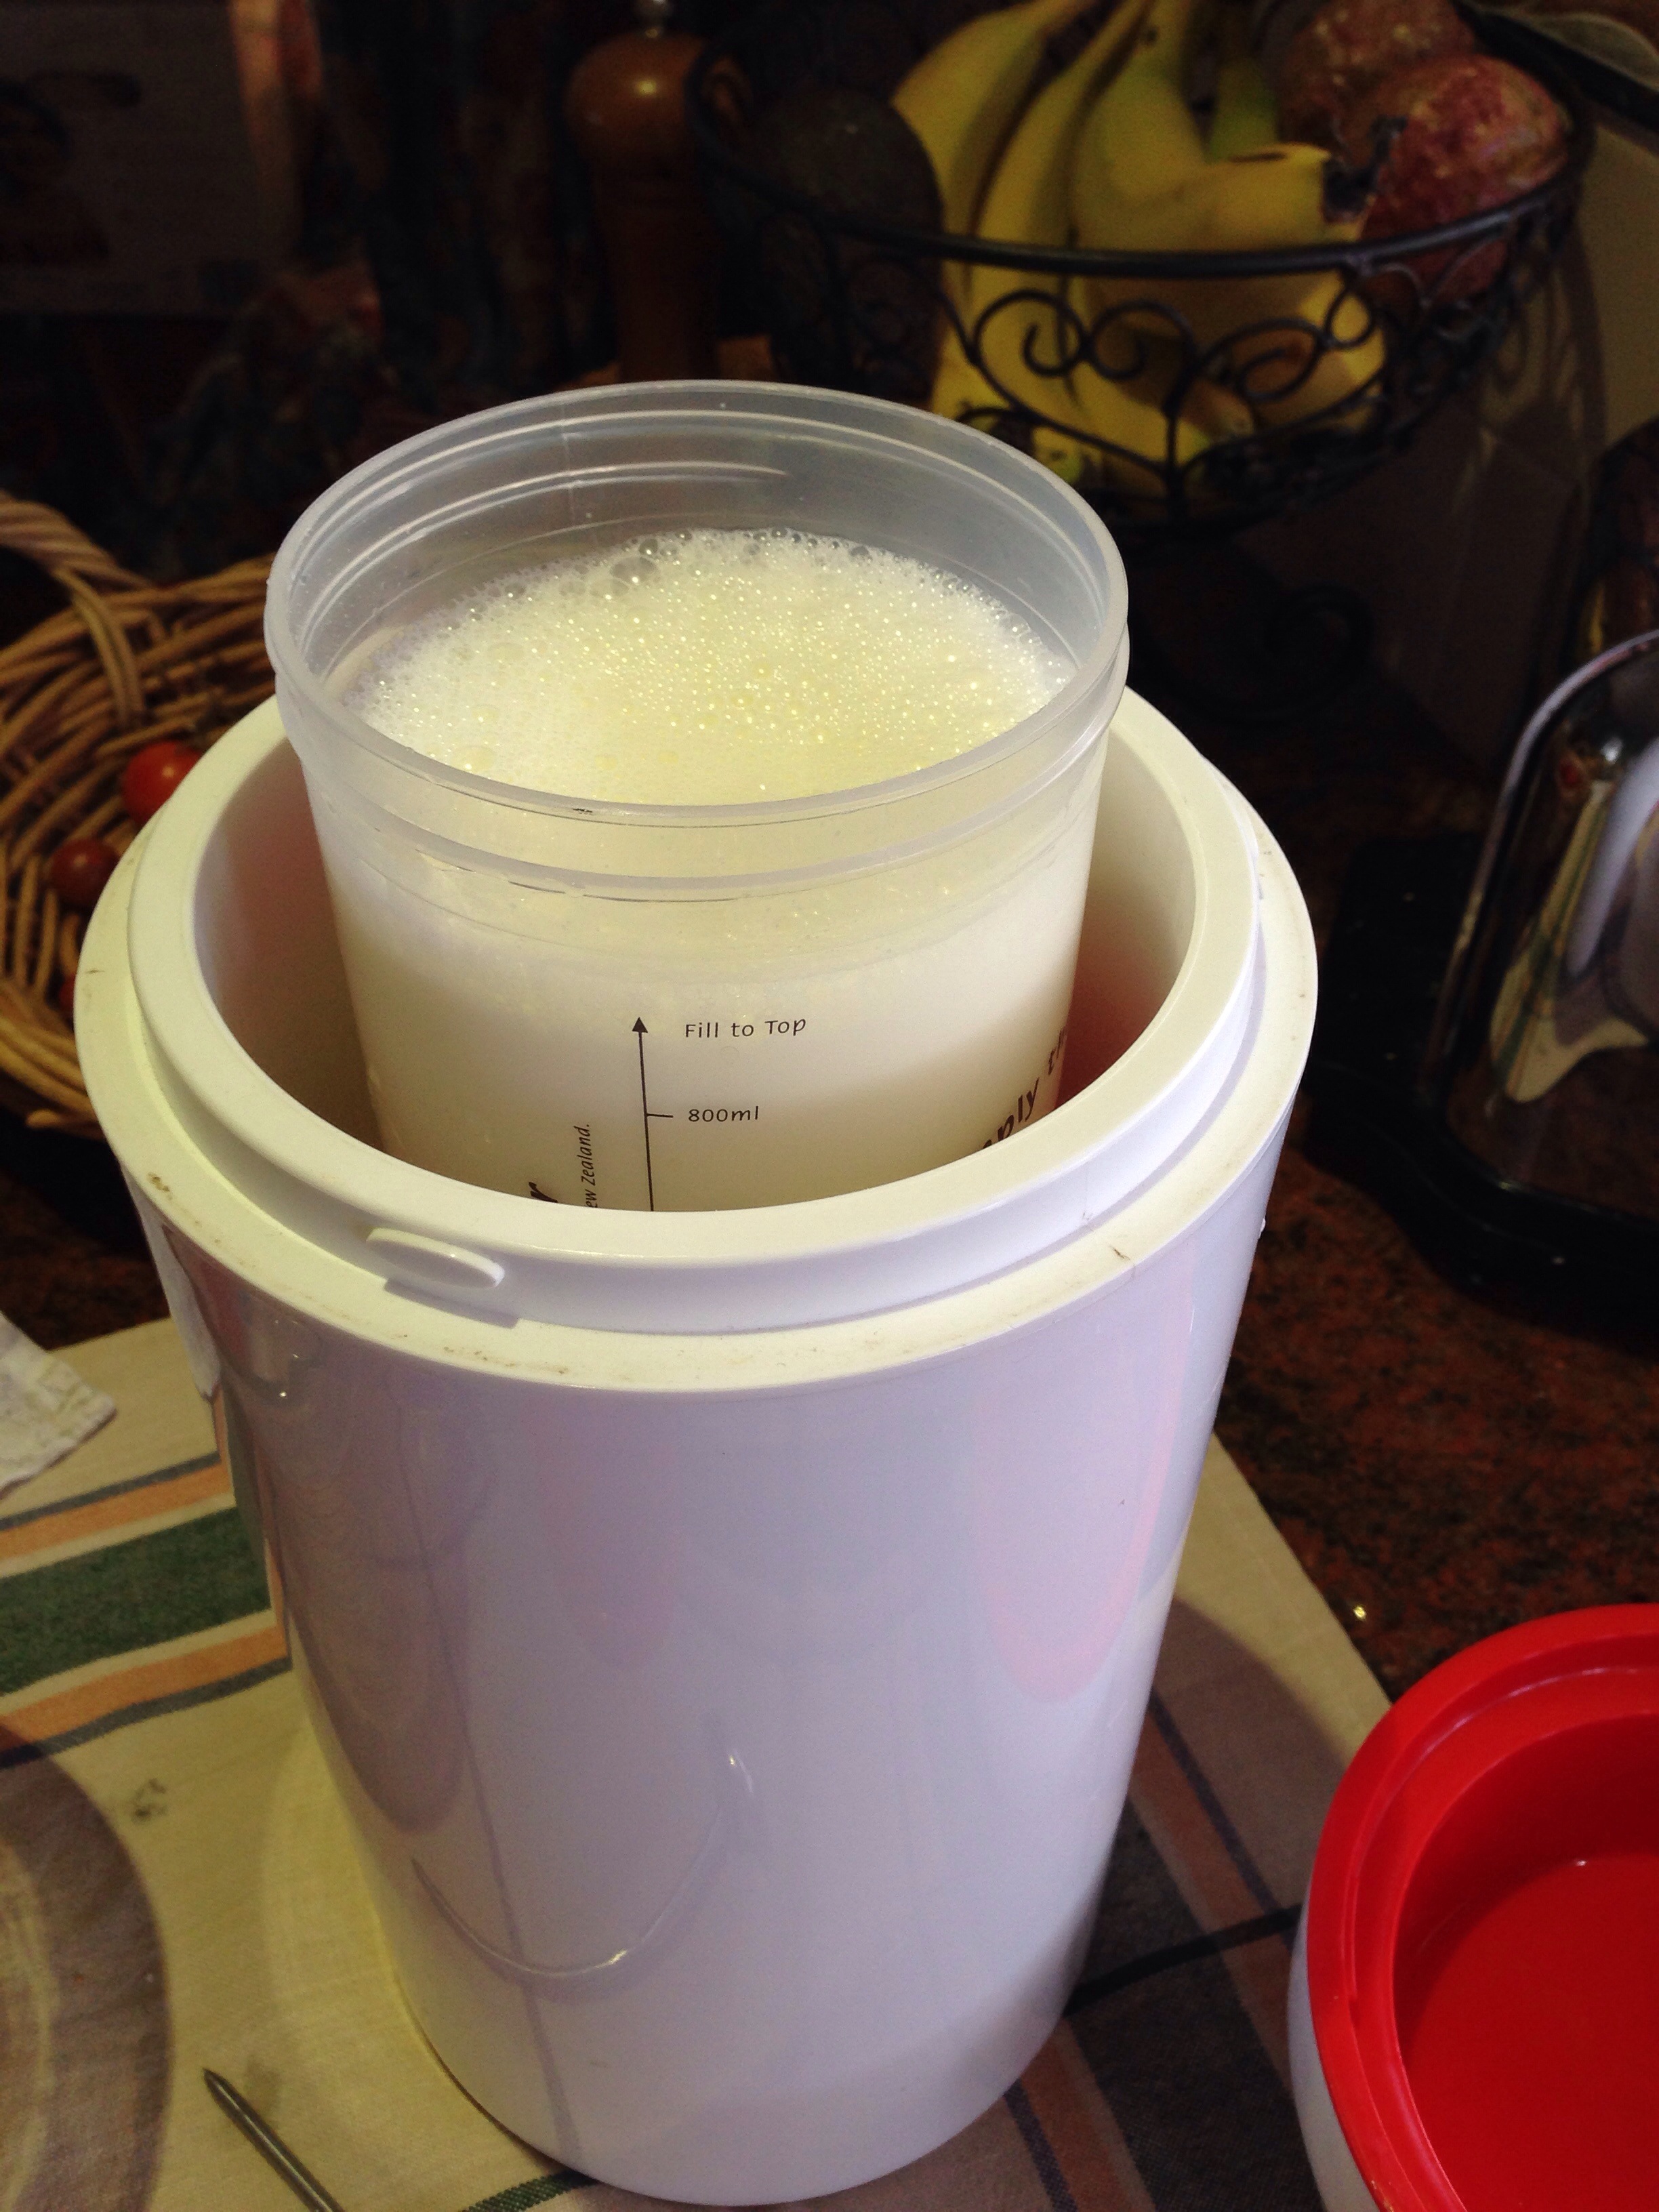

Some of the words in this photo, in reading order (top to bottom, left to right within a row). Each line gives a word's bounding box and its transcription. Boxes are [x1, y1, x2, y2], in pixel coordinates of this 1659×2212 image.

[686, 1022, 718, 1038] Fill
[731, 1023, 754, 1037] to
[764, 1019, 806, 1036] Top
[689, 1106, 758, 1122] 800ml
[982, 1077, 1040, 1149] ply
[573, 1124, 596, 1186] Zealand.
[585, 1189, 598, 1208] ew
